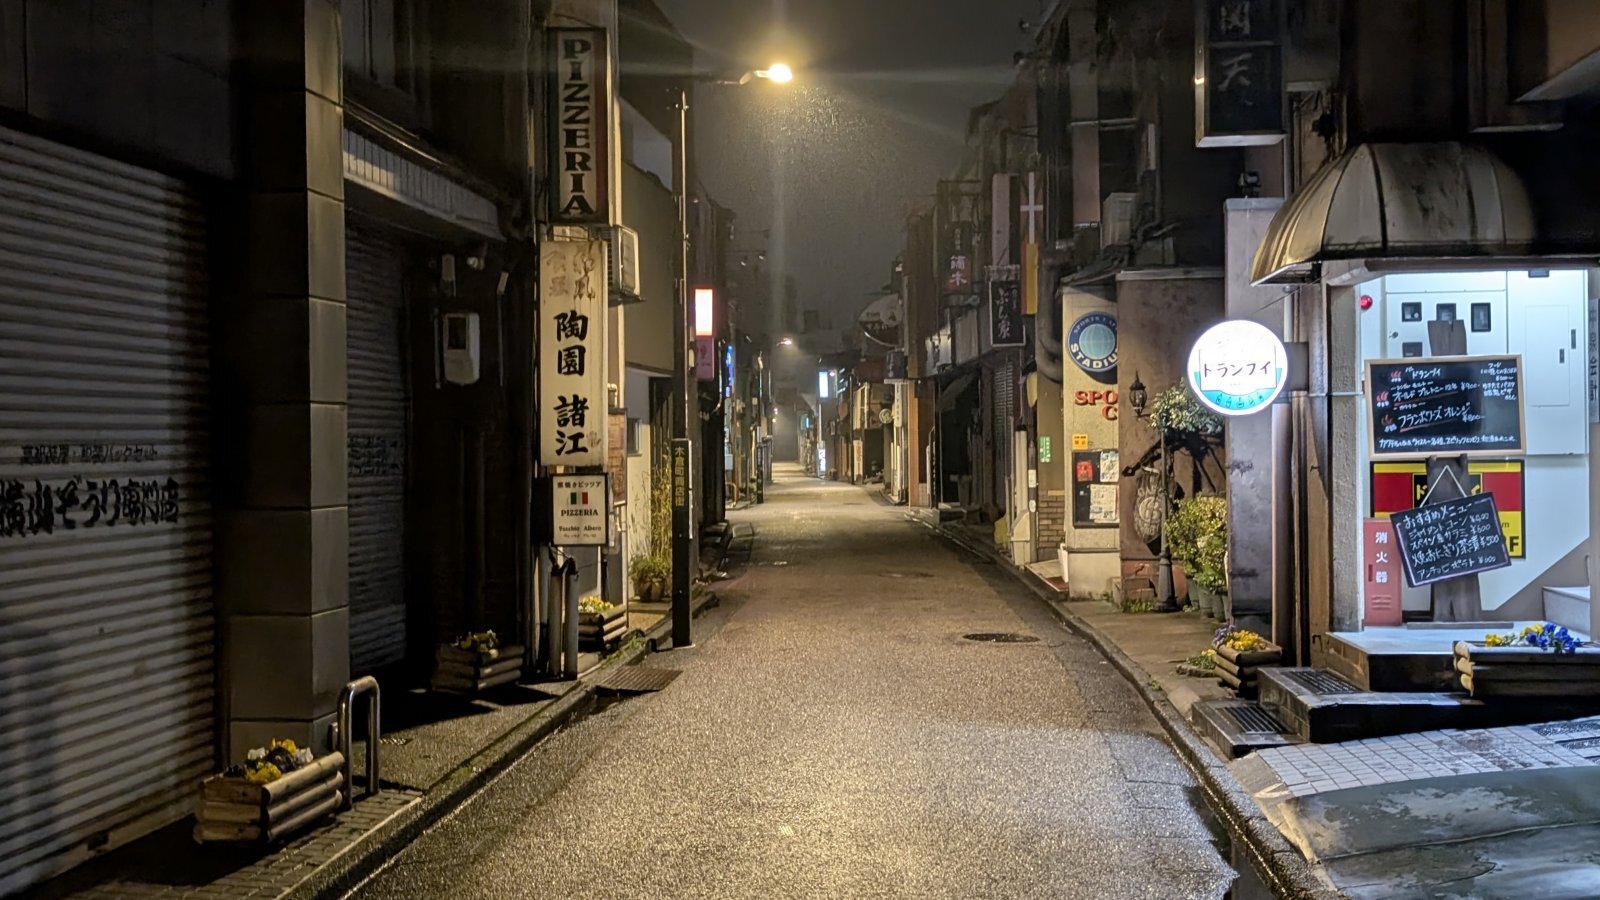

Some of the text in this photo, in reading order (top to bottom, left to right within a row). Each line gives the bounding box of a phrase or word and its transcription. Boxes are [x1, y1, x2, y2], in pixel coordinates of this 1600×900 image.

[562, 38, 596, 216] PIZZERIA
[554, 310, 589, 456] 陶園 諸江
[561, 508, 599, 518] PIZZERIA
[1403, 503, 1473, 530] おすすめメニュー
[1375, 531, 1389, 584] 消火器
